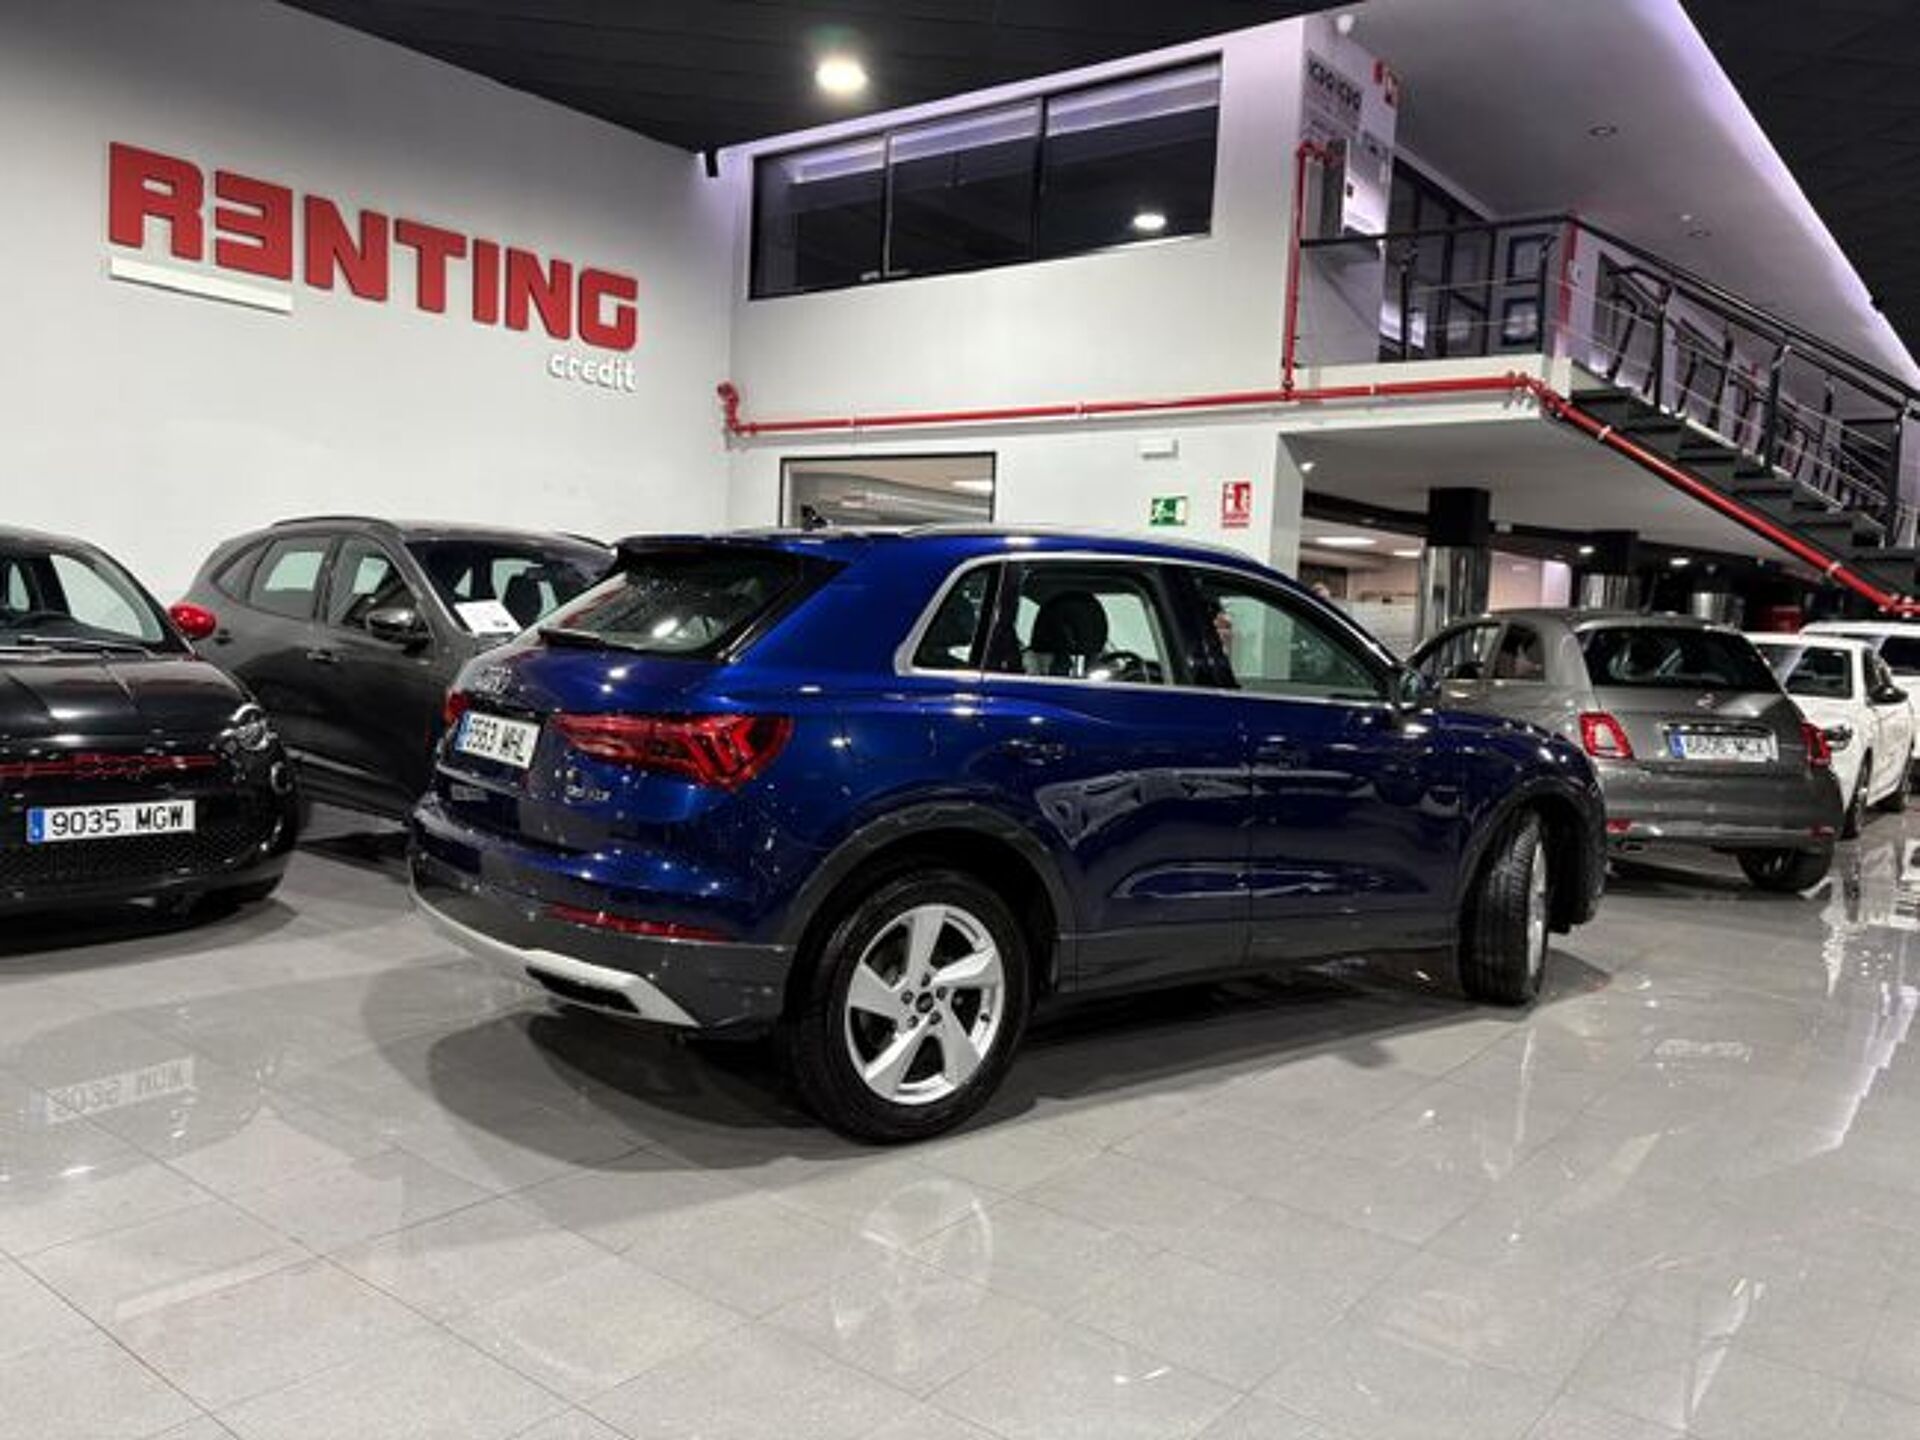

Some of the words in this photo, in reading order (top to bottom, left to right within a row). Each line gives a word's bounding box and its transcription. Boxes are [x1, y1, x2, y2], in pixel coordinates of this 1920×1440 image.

[547, 354, 637, 391] credit
[51, 808, 122, 836] 9035
[135, 804, 185, 830] MGW
